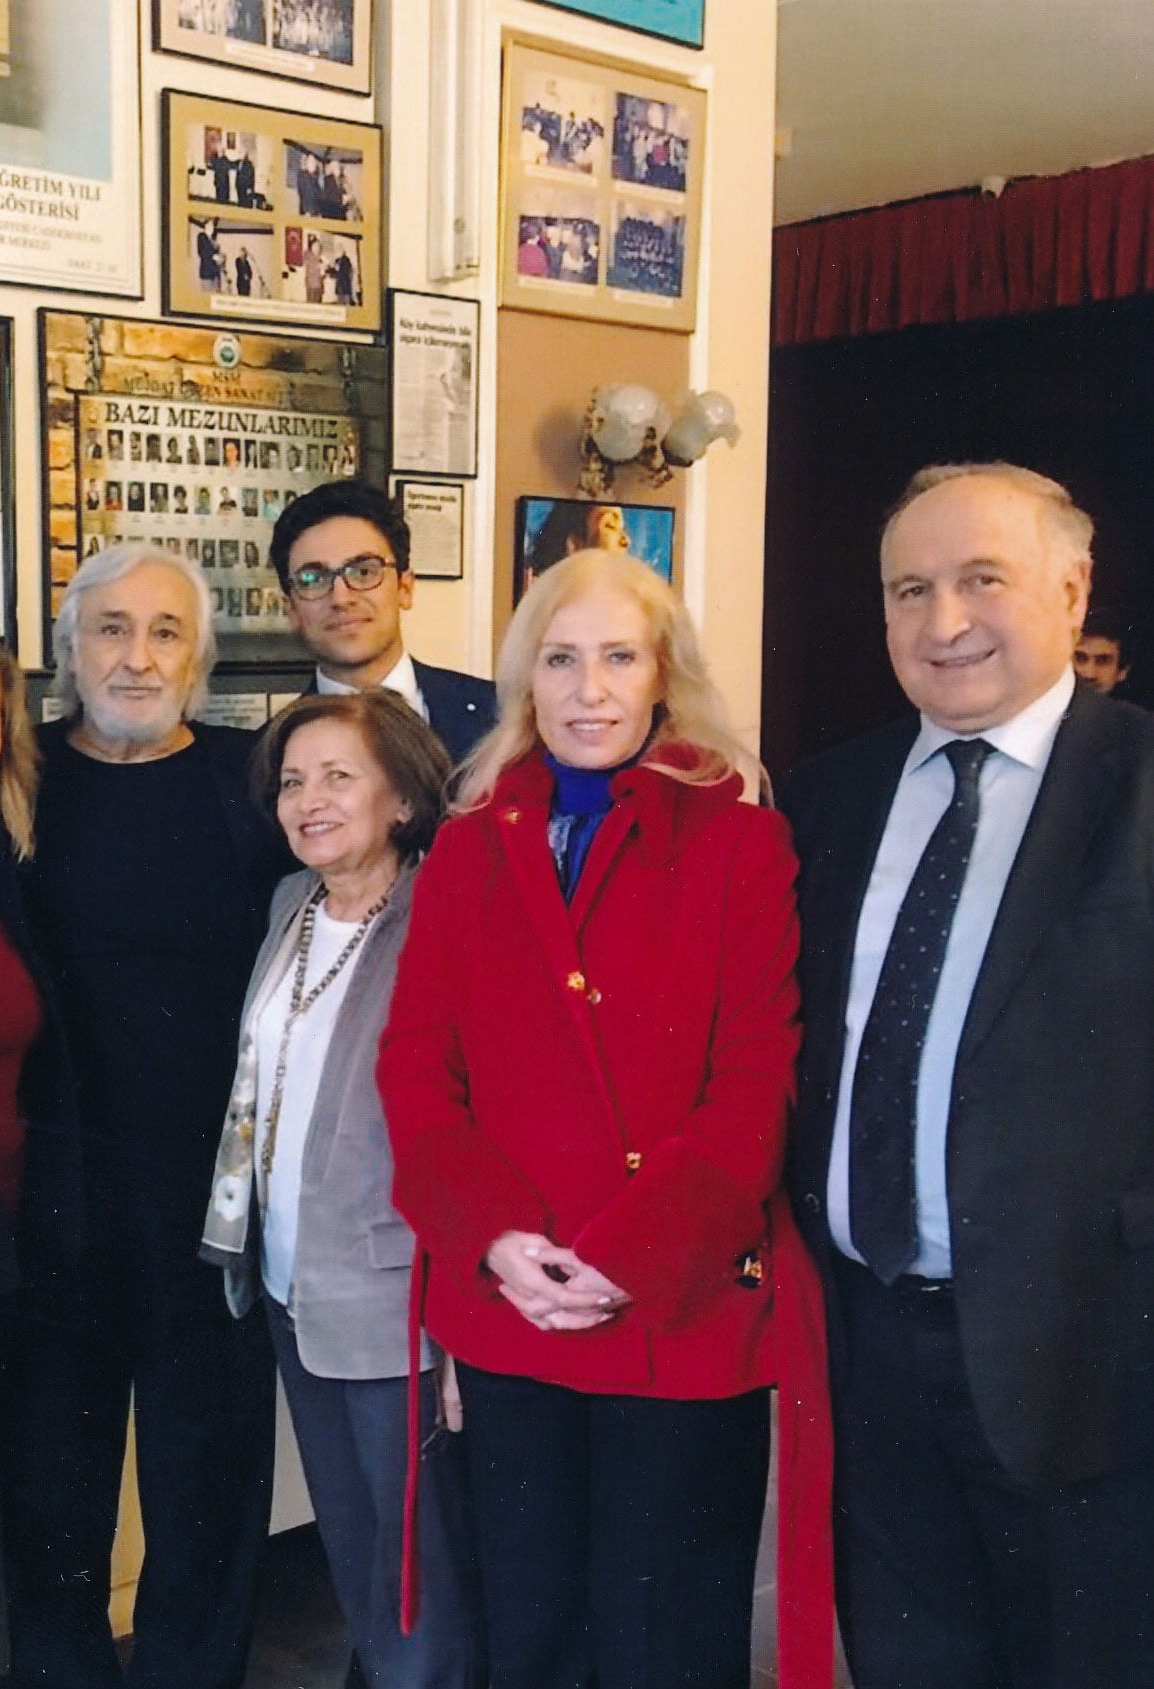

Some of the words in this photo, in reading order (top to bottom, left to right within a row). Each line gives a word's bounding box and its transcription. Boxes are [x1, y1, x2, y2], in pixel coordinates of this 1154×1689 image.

[68, 183, 102, 201] YILI
[105, 402, 160, 426] BAZI
[166, 406, 339, 440] MEZUNLARIMIZ
